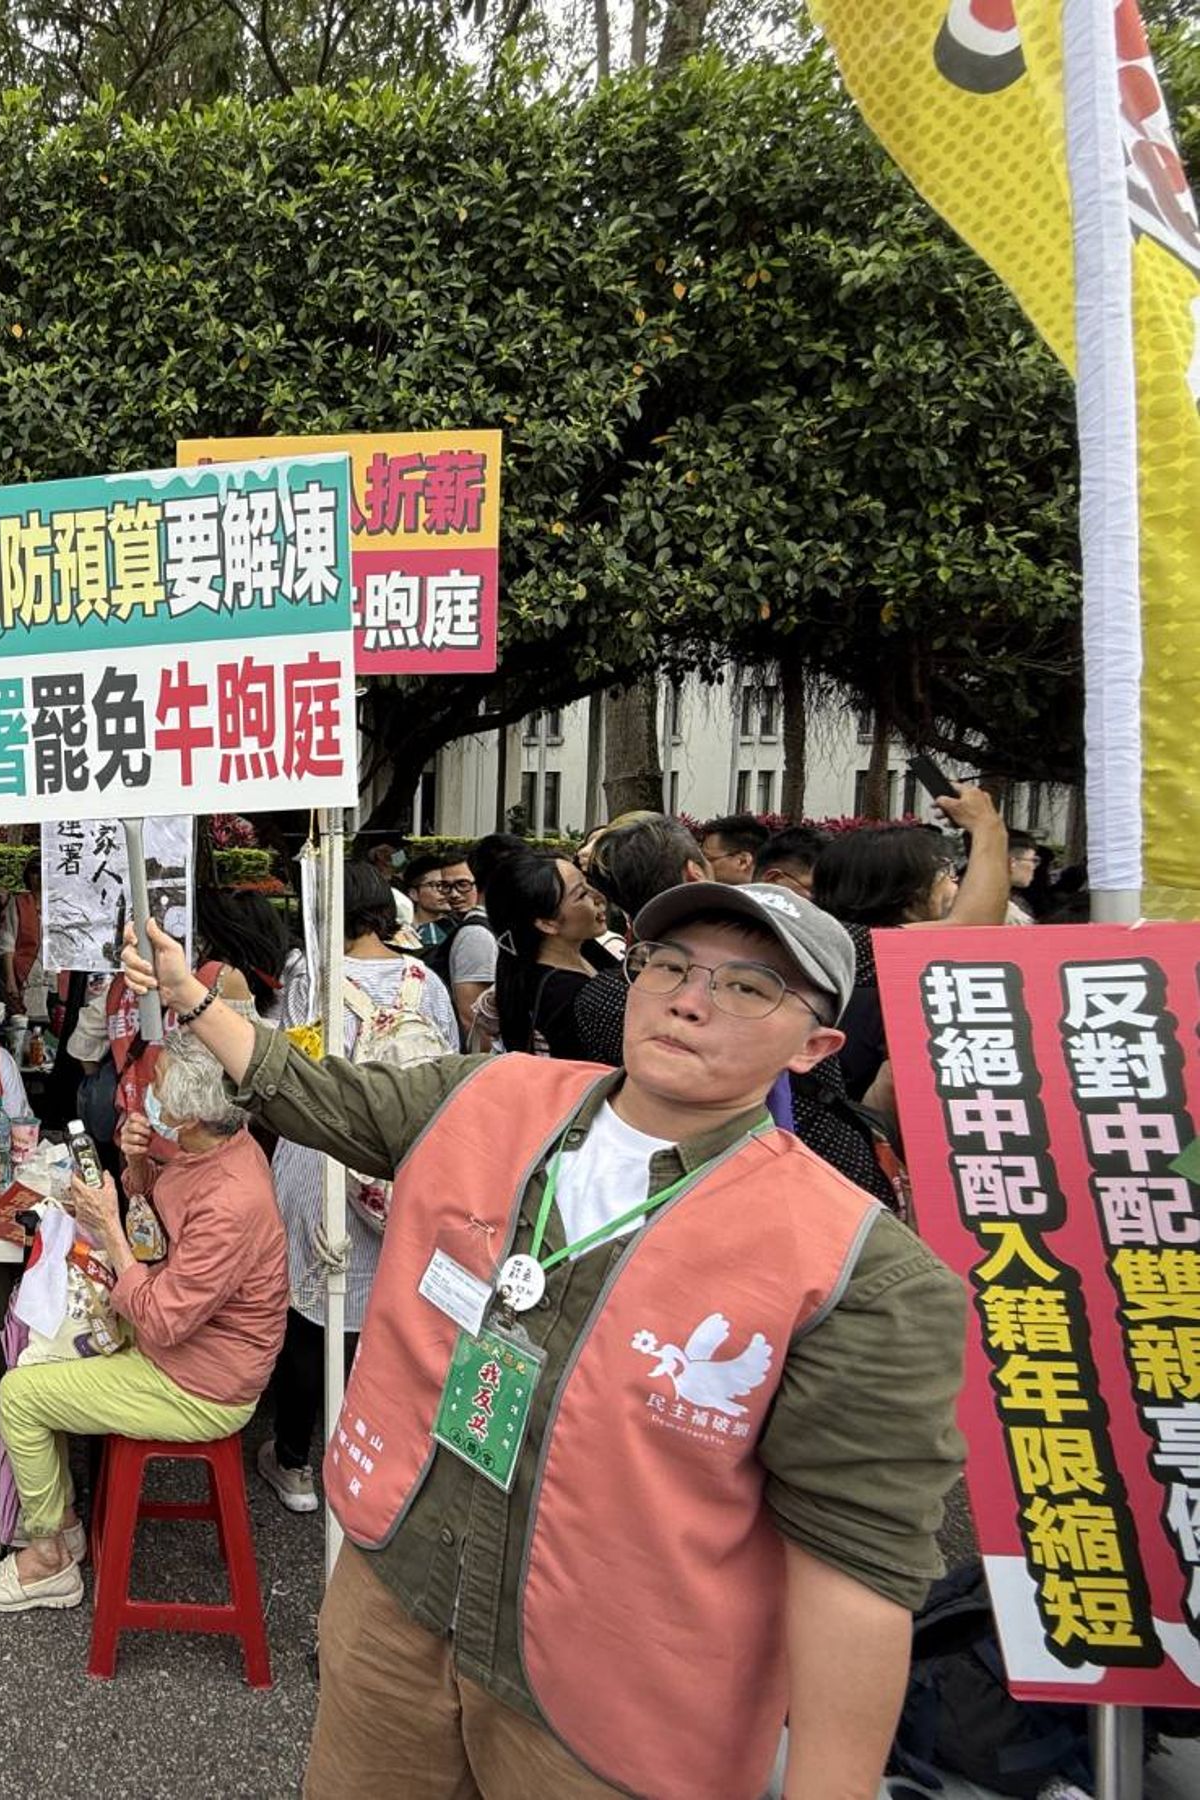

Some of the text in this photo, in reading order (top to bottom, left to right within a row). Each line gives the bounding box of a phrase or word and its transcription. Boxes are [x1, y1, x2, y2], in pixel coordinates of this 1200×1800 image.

[351, 450, 489, 535] 折薪
[352, 570, 482, 651] 煦庭
[923, 965, 1143, 1648] 拒絕中配入籍年限縮短
[1062, 963, 1200, 1622] 反對中配雙親享
